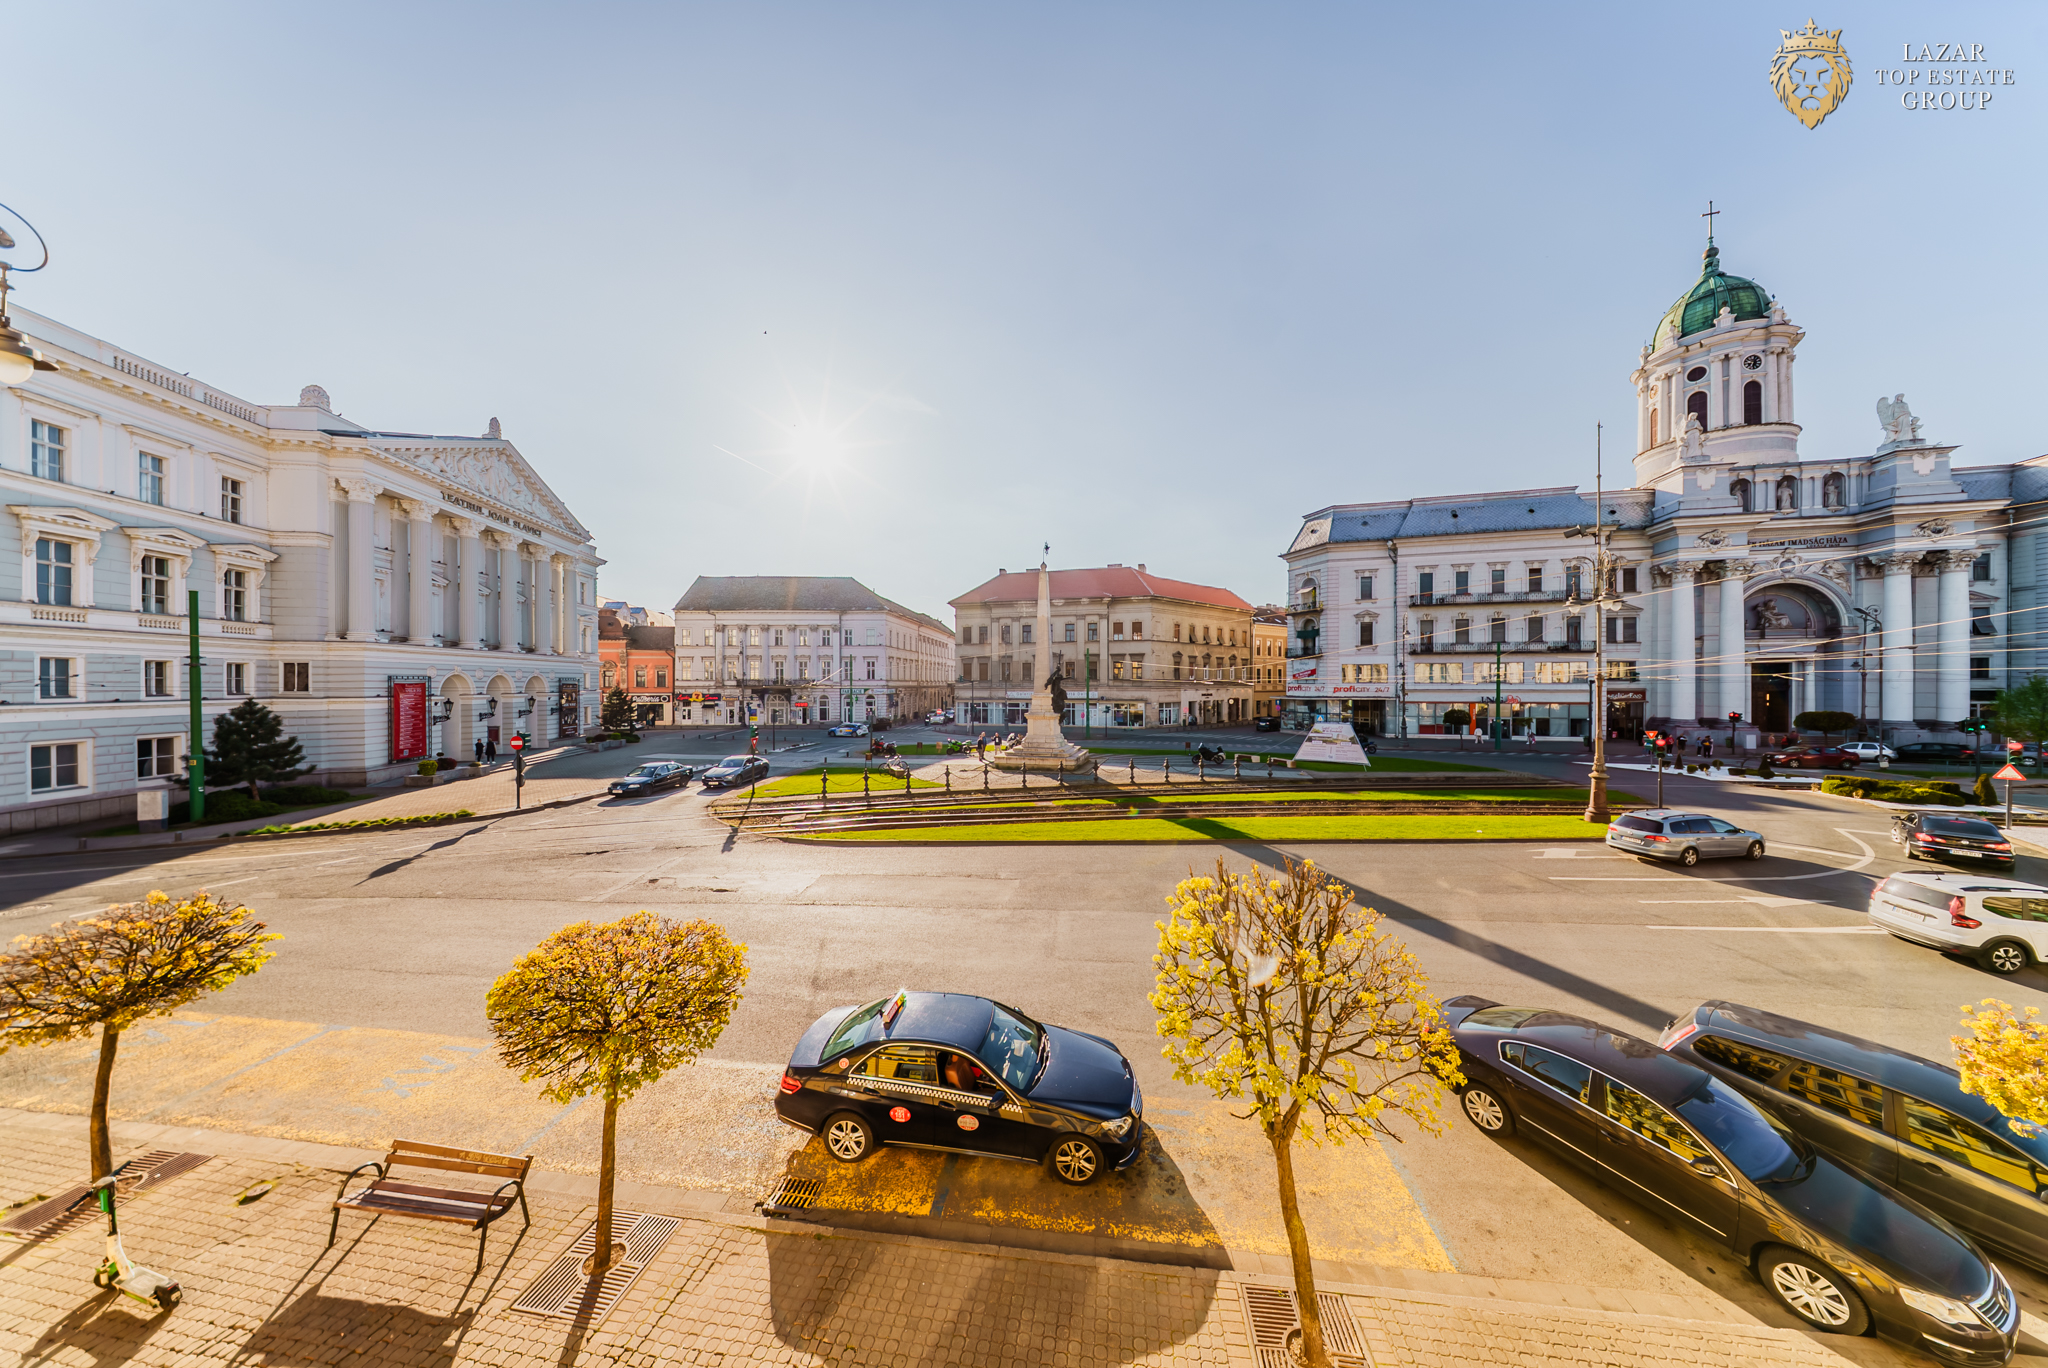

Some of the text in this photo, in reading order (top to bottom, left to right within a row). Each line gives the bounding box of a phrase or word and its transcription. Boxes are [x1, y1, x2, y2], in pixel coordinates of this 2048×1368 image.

[440, 491, 484, 515] TEATRUL
[512, 520, 542, 537] SLAVICI
[1826, 536, 1848, 544] HÁZA
[1333, 685, 1370, 693] profiCITY
